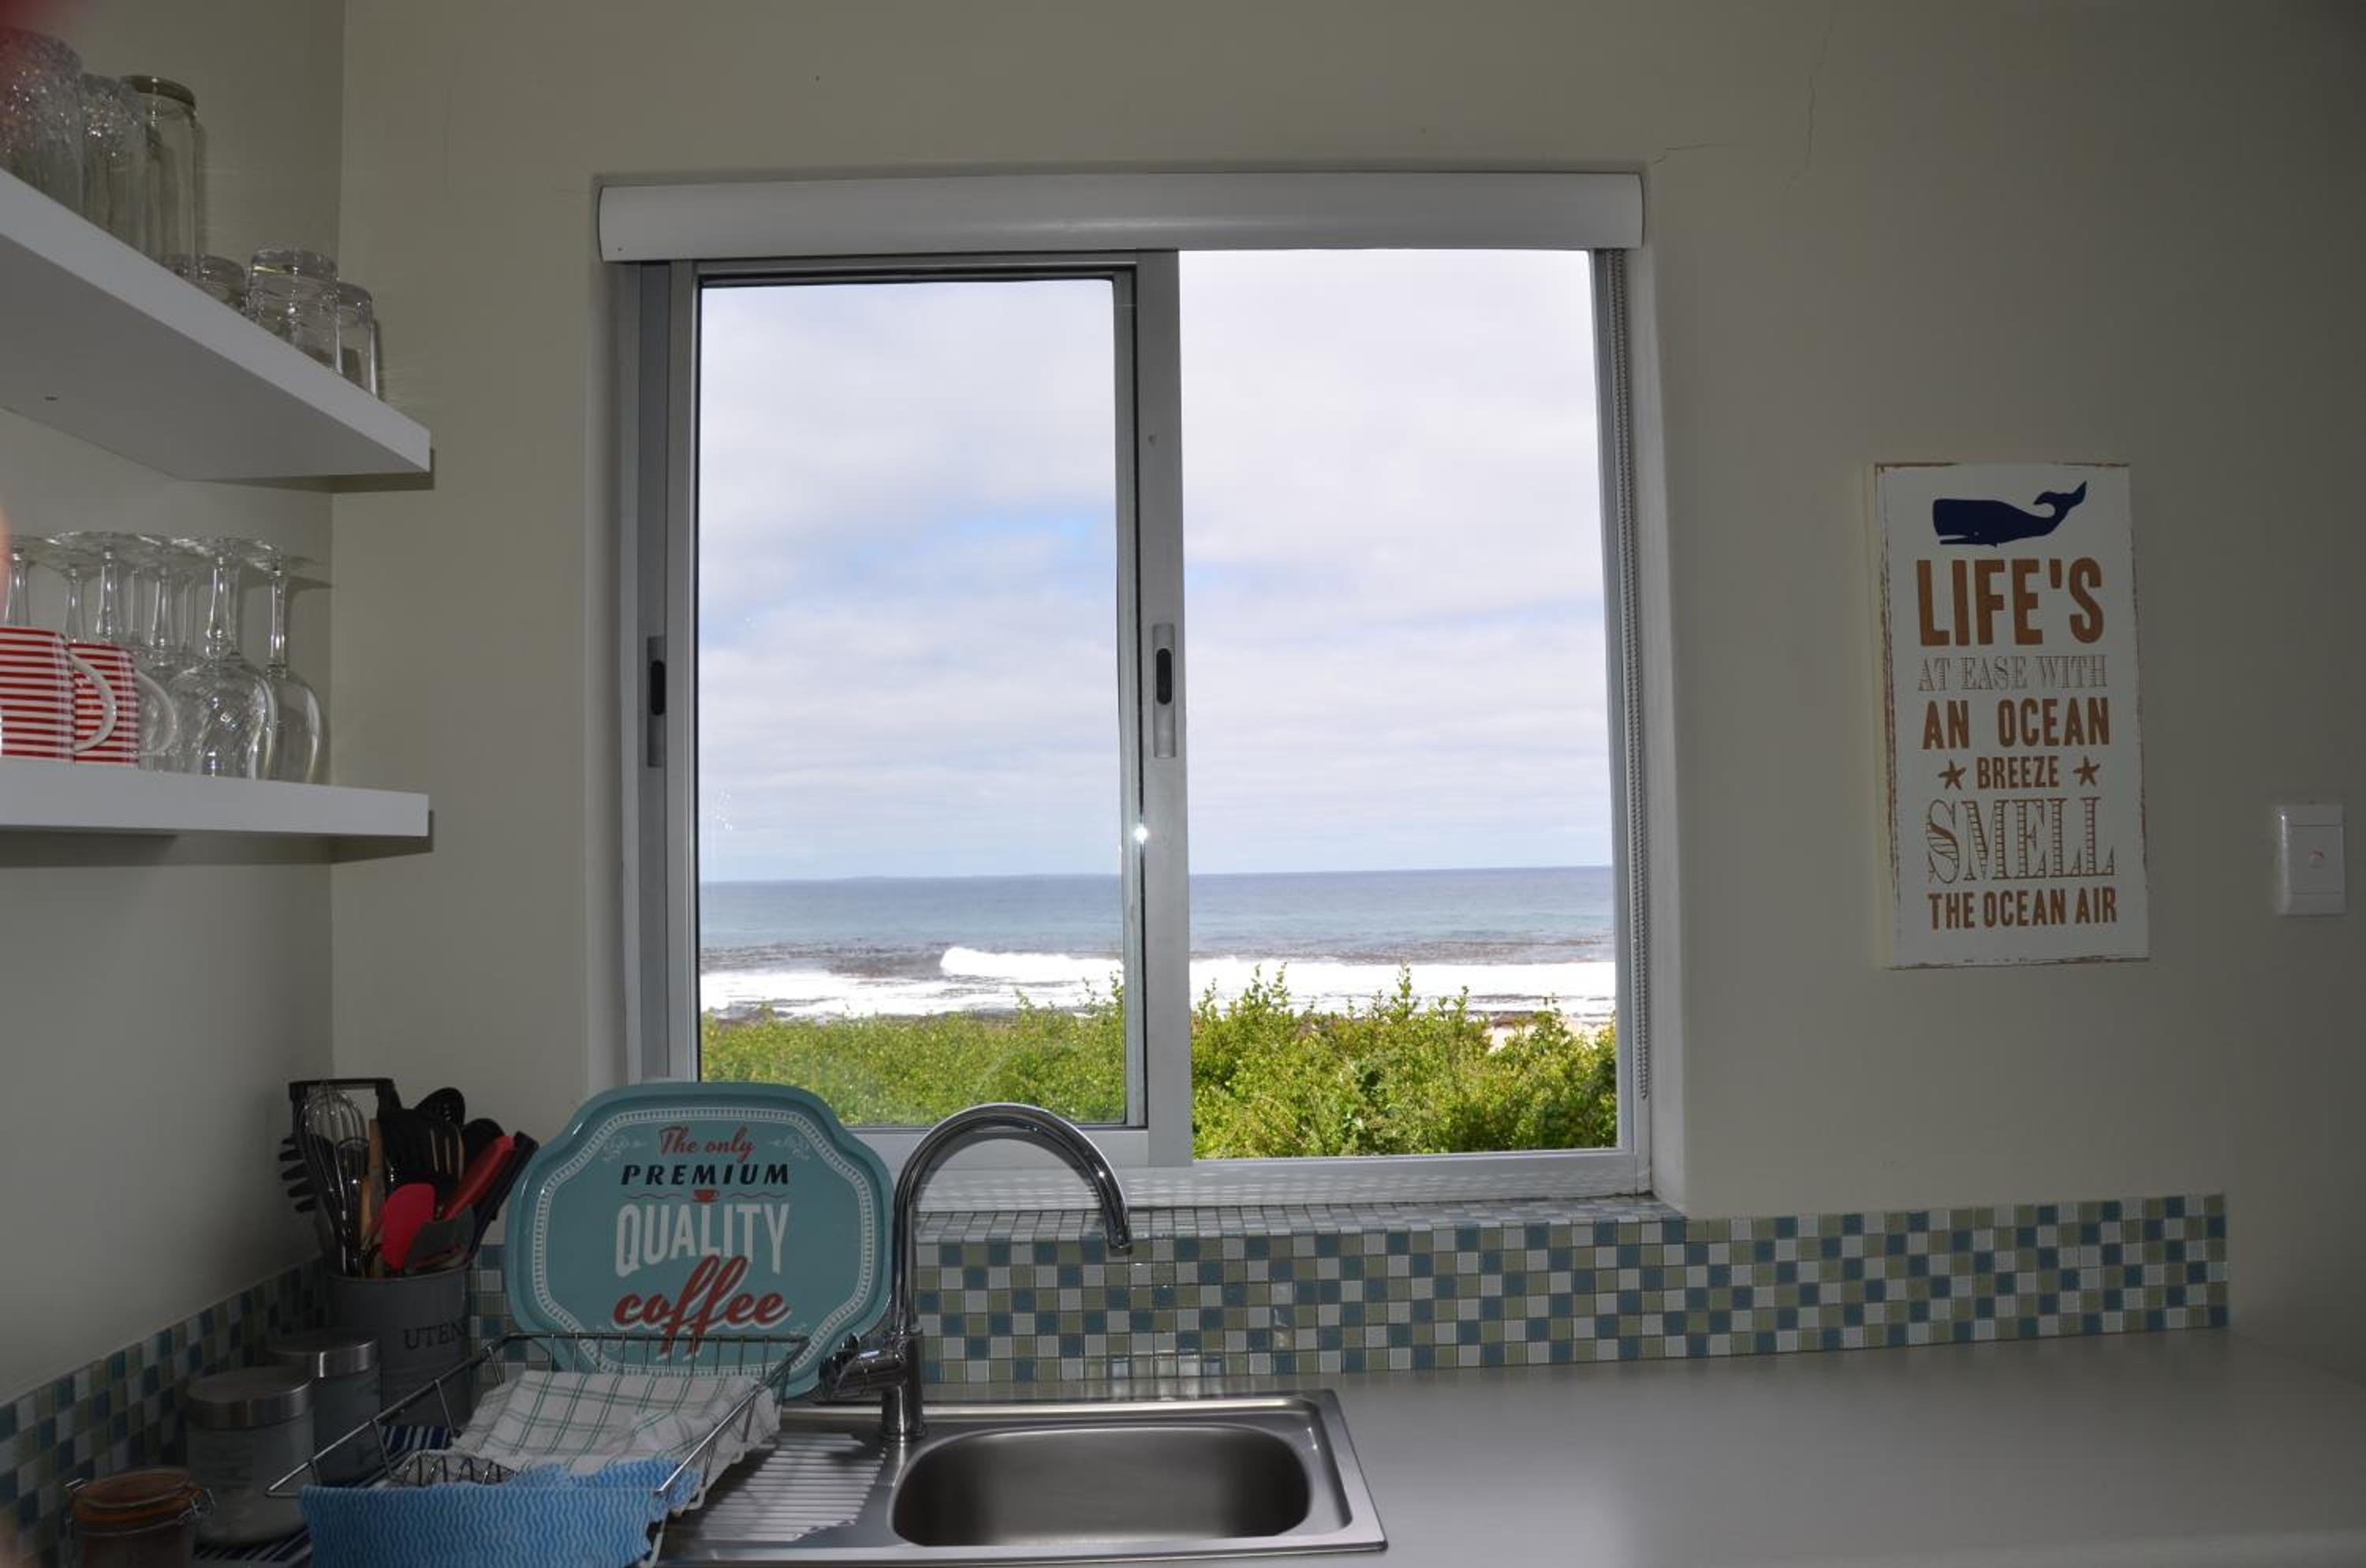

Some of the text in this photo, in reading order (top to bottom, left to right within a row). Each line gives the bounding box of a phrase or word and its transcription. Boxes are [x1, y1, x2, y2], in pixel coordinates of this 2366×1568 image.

[1916, 556, 2104, 647] LIFE'S
[1918, 654, 2108, 692] AT EASE WITH
[1923, 696, 2110, 749] AN OCEAN
[1977, 756, 2060, 790] BREEZE
[1927, 797, 2115, 884] SMELL
[1928, 886, 2118, 930] THE OCEAN AIR
[659, 1126, 754, 1163] The only
[621, 1163, 789, 1185] PREMIUM
[615, 1203, 789, 1278] QUALITY
[613, 1254, 790, 1361] coffee
